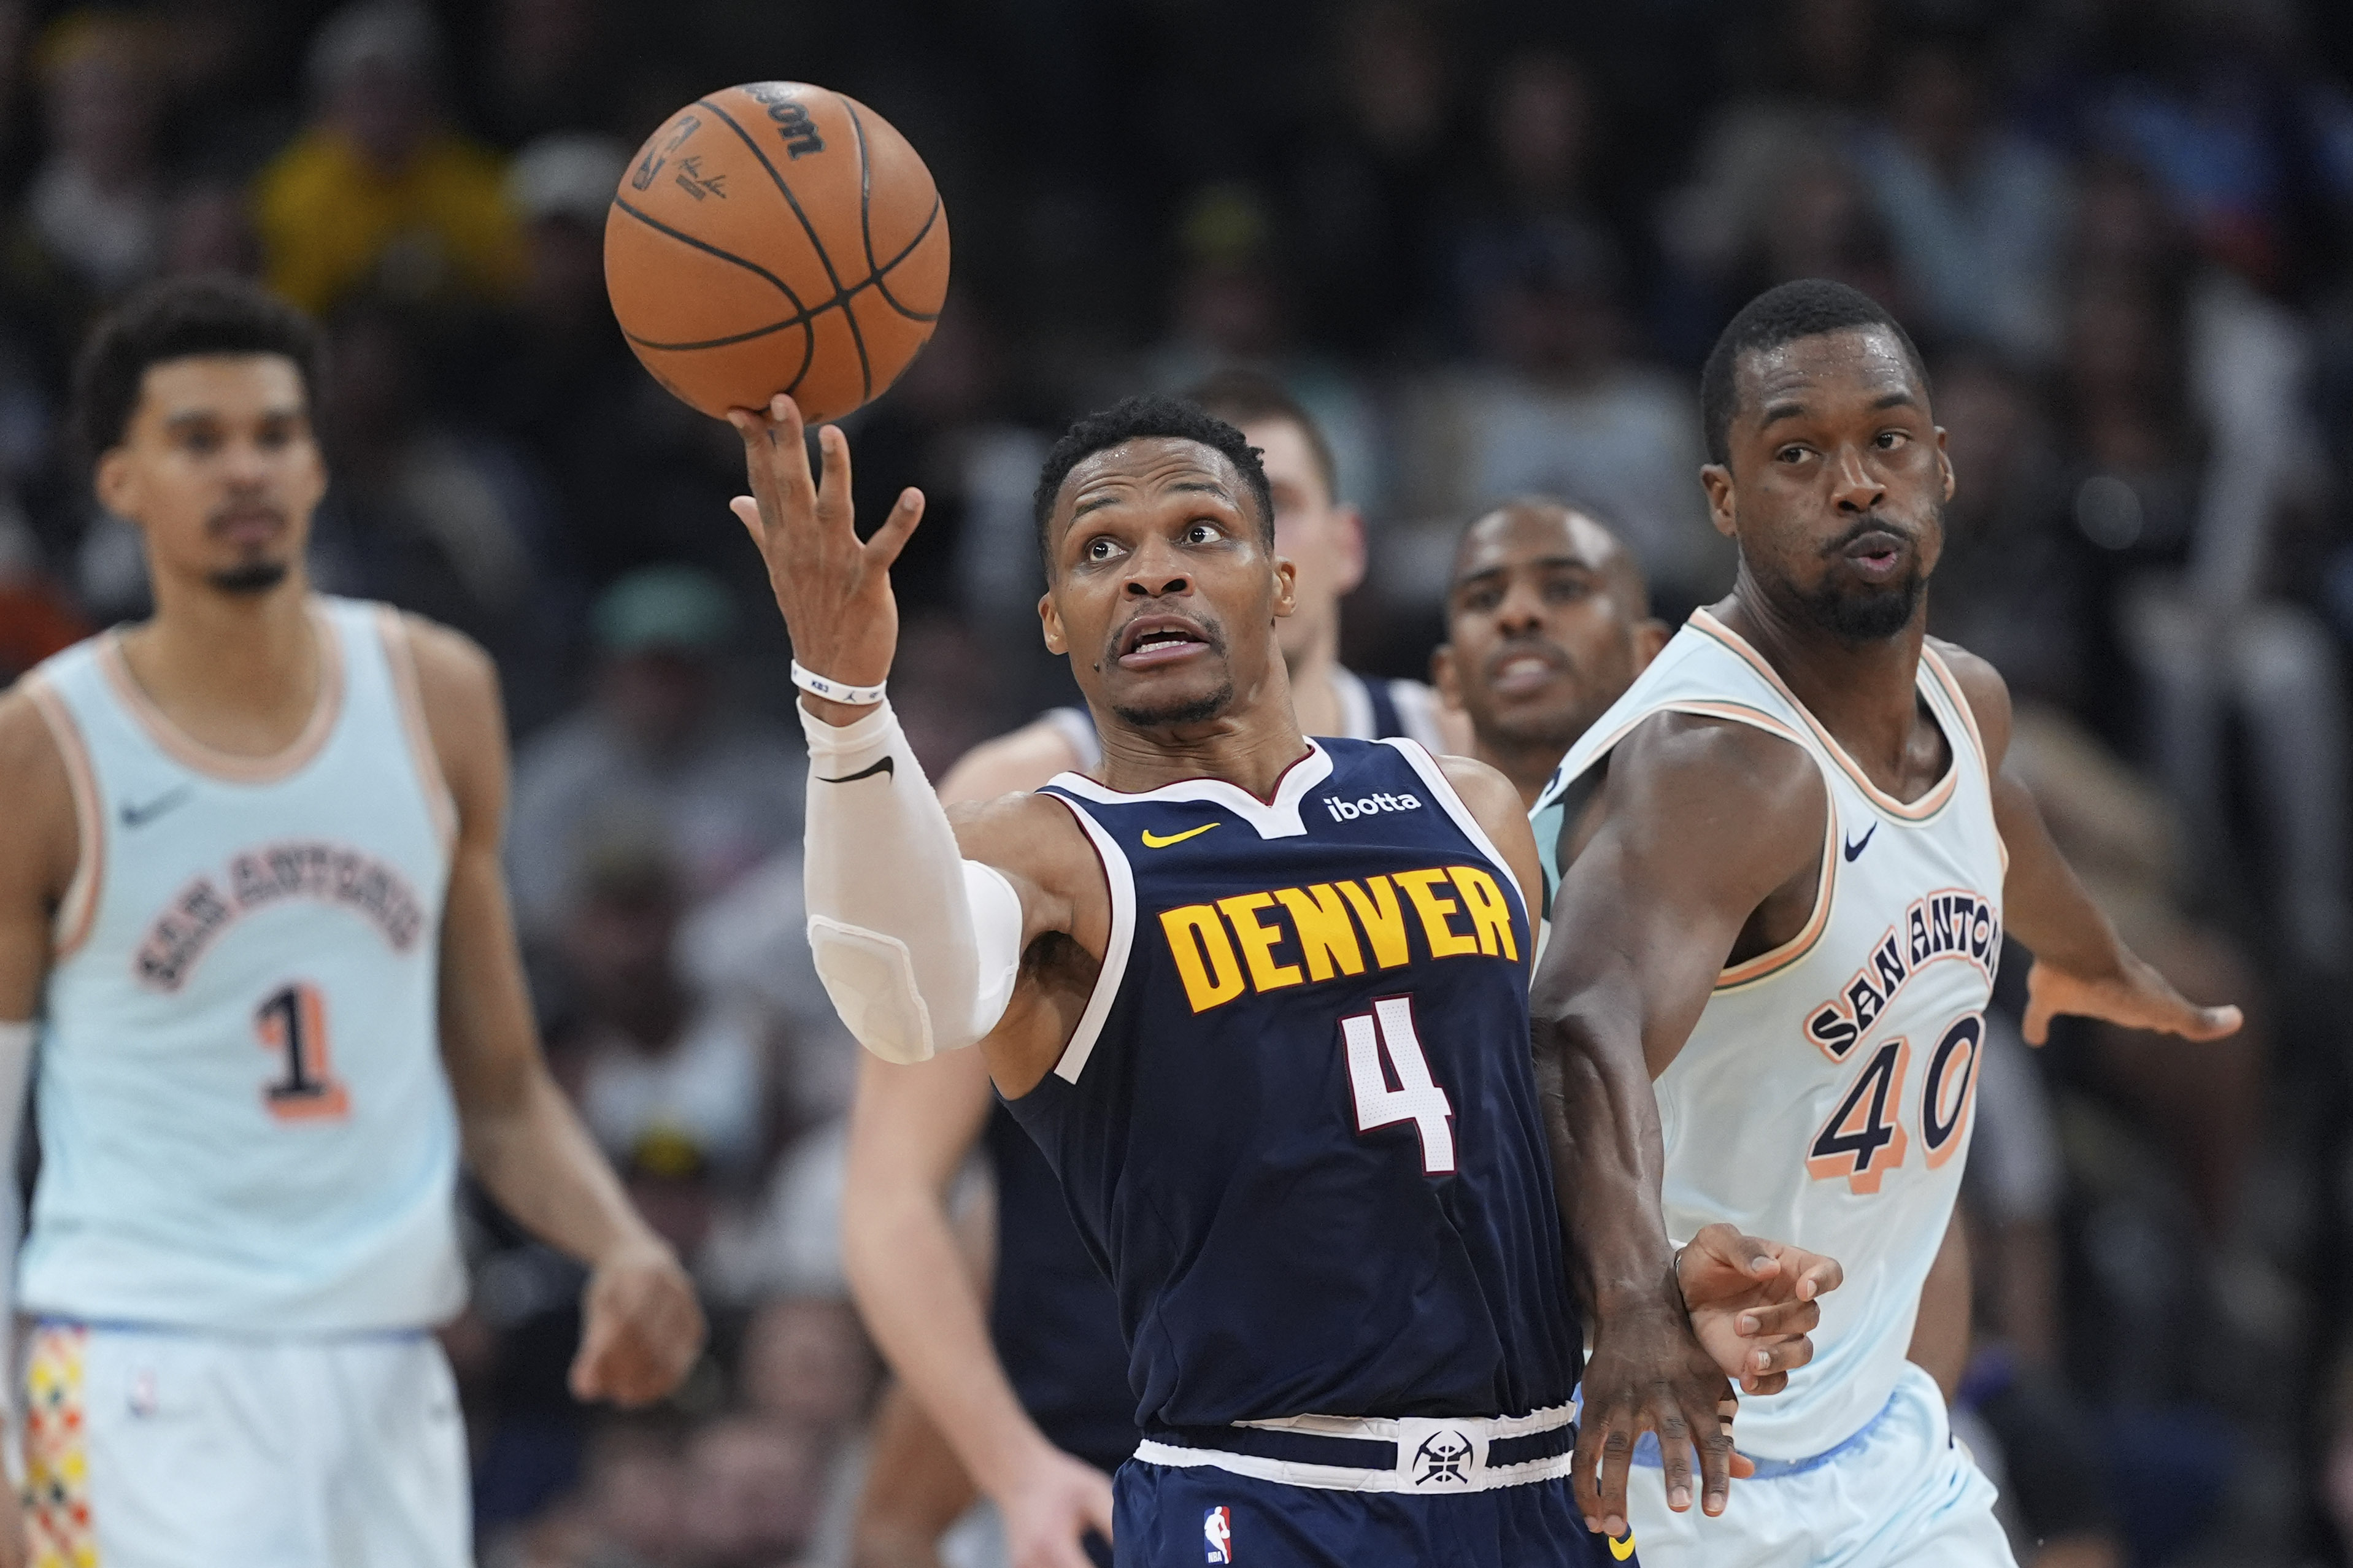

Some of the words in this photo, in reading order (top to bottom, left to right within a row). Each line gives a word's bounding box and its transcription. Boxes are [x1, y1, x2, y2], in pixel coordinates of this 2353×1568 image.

[1323, 793, 1422, 823] ibotta
[1157, 865, 1520, 1017] DENVER
[1804, 926, 1908, 1063] SAN
[254, 982, 347, 1120] 1
[1339, 992, 1458, 1177] 4
[1806, 1011, 1984, 1192] 40
[1207, 1550, 1223, 1564] NBA
